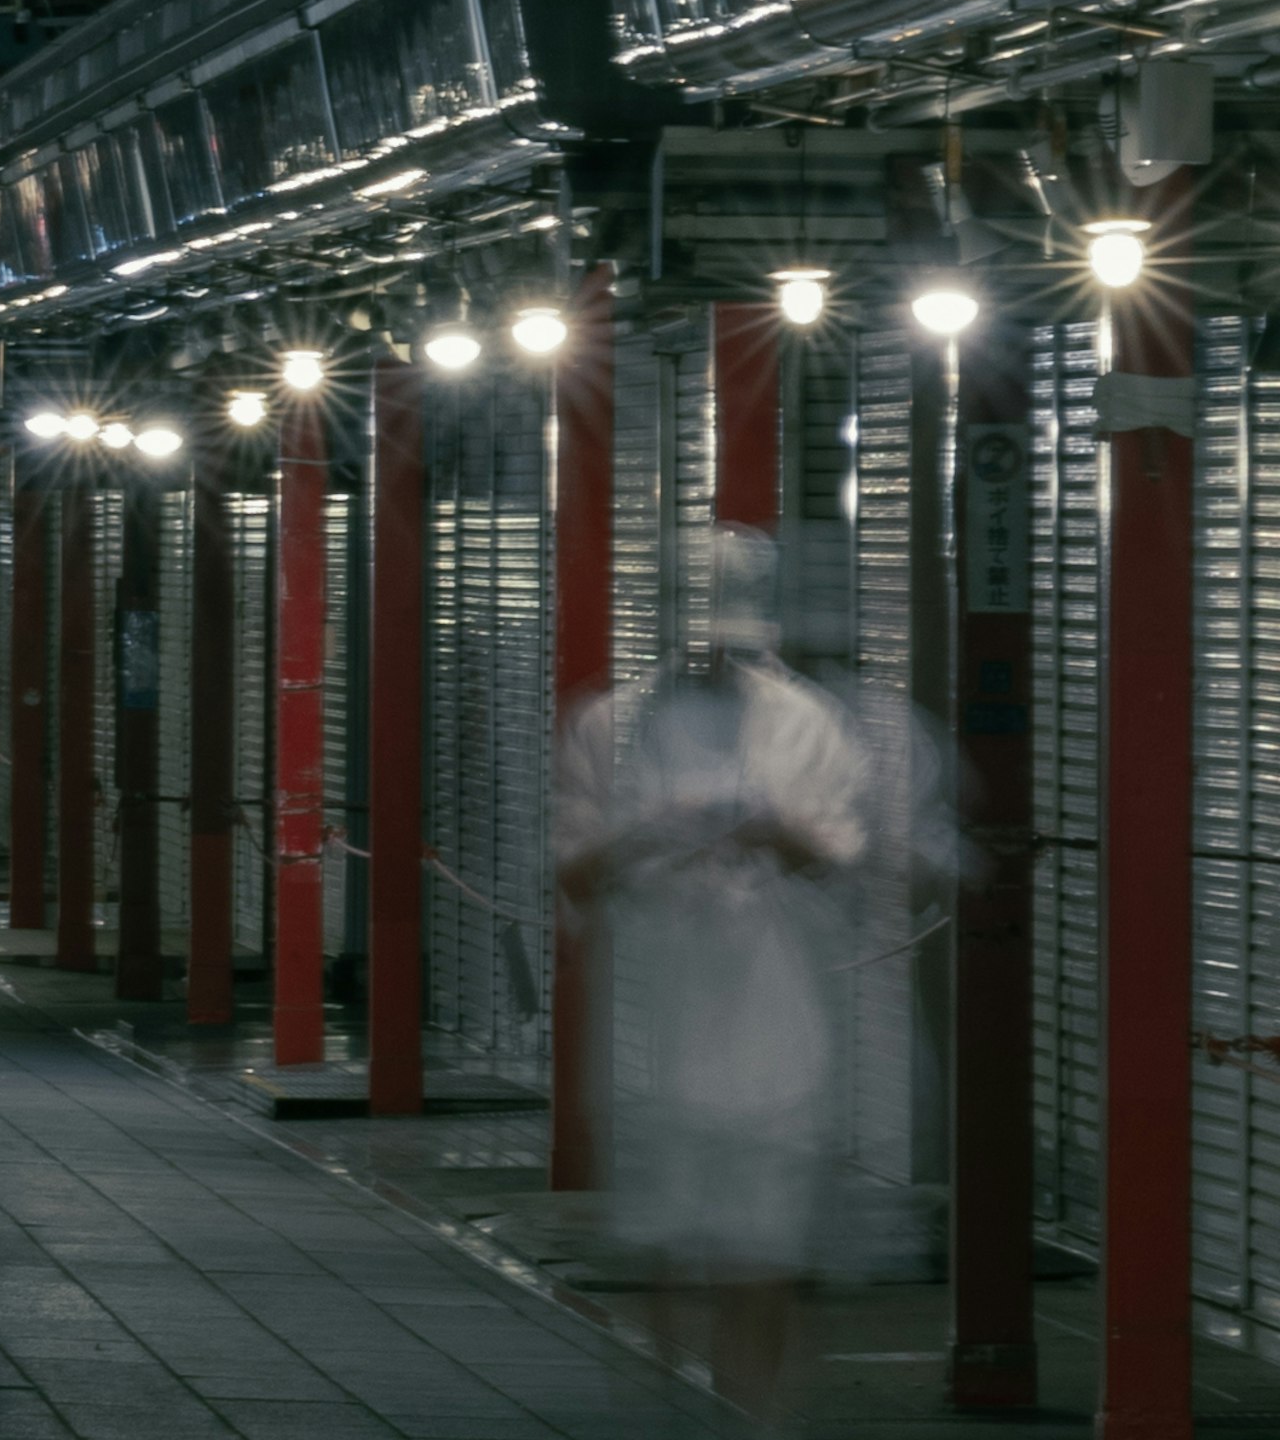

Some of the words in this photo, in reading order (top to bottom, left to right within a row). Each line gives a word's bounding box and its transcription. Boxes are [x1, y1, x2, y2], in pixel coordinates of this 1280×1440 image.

[987, 487, 1010, 607] ポイ捨て禁止
